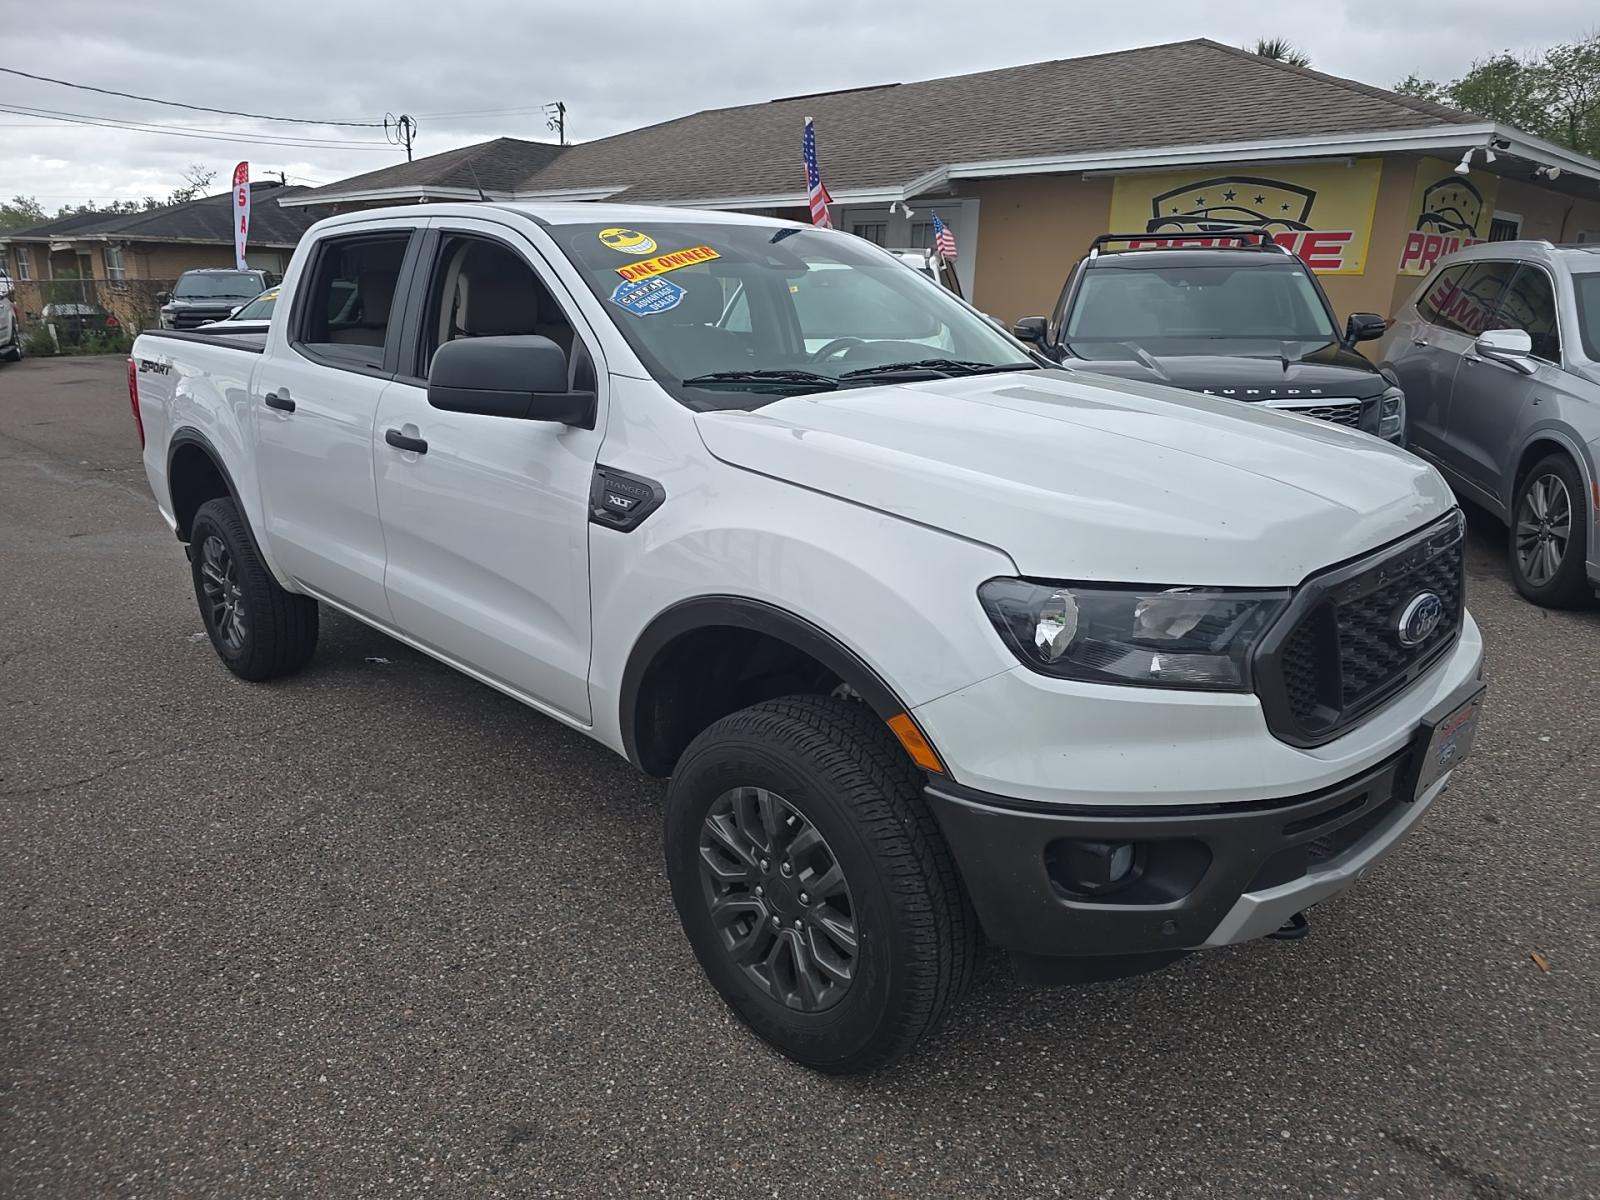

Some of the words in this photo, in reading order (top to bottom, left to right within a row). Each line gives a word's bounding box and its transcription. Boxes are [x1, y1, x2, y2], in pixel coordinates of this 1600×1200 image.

[238, 187, 247, 260] SAL
[619, 261, 657, 280] ONE
[657, 246, 715, 268] OWNER
[1400, 232, 1488, 270] PRI
[622, 279, 668, 305] CARFAX
[634, 286, 675, 309] ADVANTAGE
[648, 294, 678, 311] DEALER
[139, 359, 172, 375] SPORT
[608, 495, 632, 508] XLT
